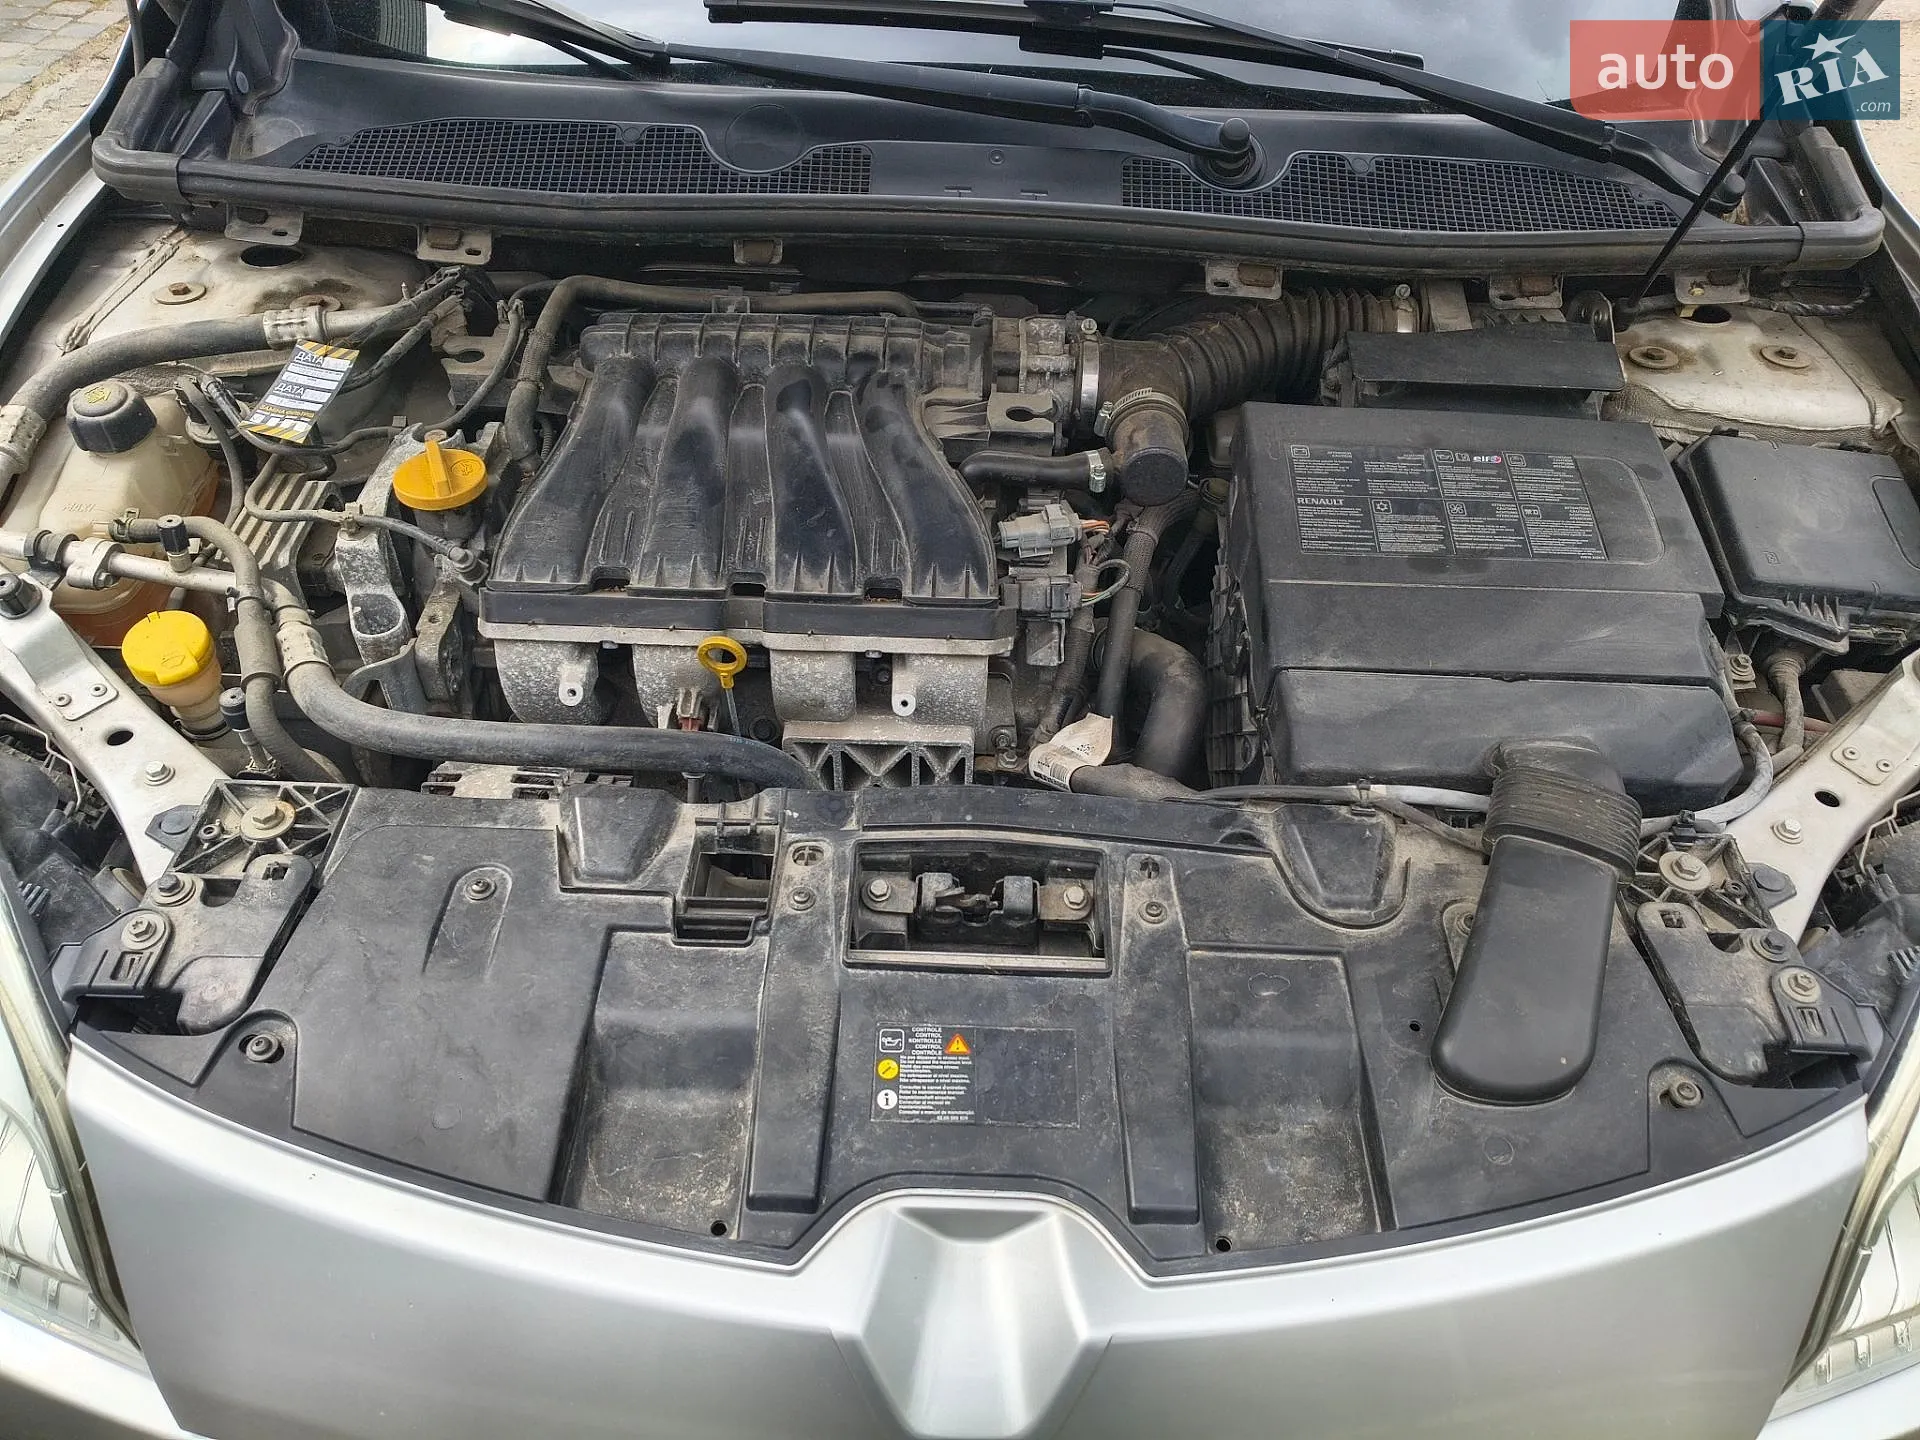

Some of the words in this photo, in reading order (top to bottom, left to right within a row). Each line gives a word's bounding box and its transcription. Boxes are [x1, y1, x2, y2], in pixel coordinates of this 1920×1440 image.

[295, 351, 325, 364] ДАТА
[275, 382, 305, 395] ДАТА
[1297, 497, 1344, 506] RENAULT
